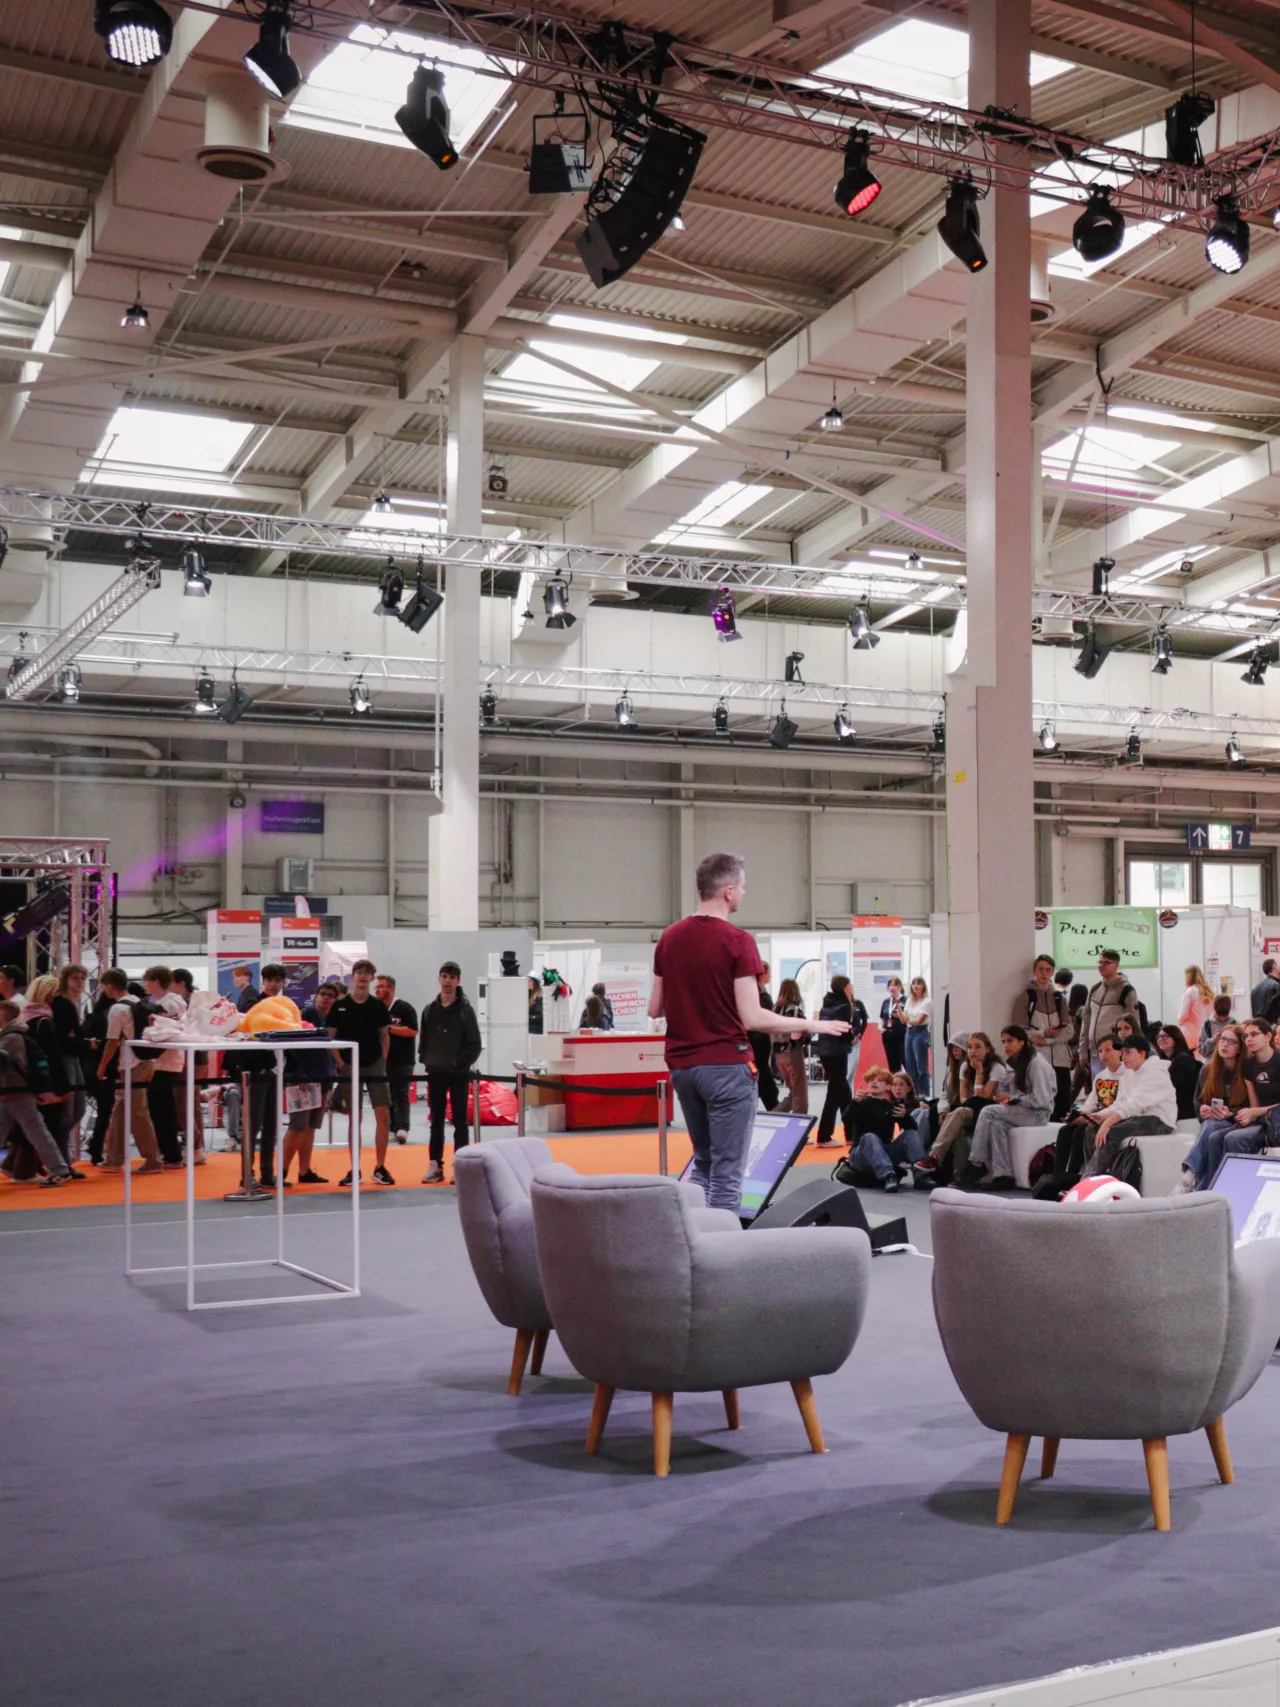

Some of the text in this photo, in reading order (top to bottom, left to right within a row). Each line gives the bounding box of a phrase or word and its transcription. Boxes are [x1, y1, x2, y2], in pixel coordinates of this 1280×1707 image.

[1235, 830, 1244, 845] 7
[1059, 921, 1109, 935] Print
[1087, 944, 1142, 957] Sre
[612, 1007, 636, 1015] ACHEN
